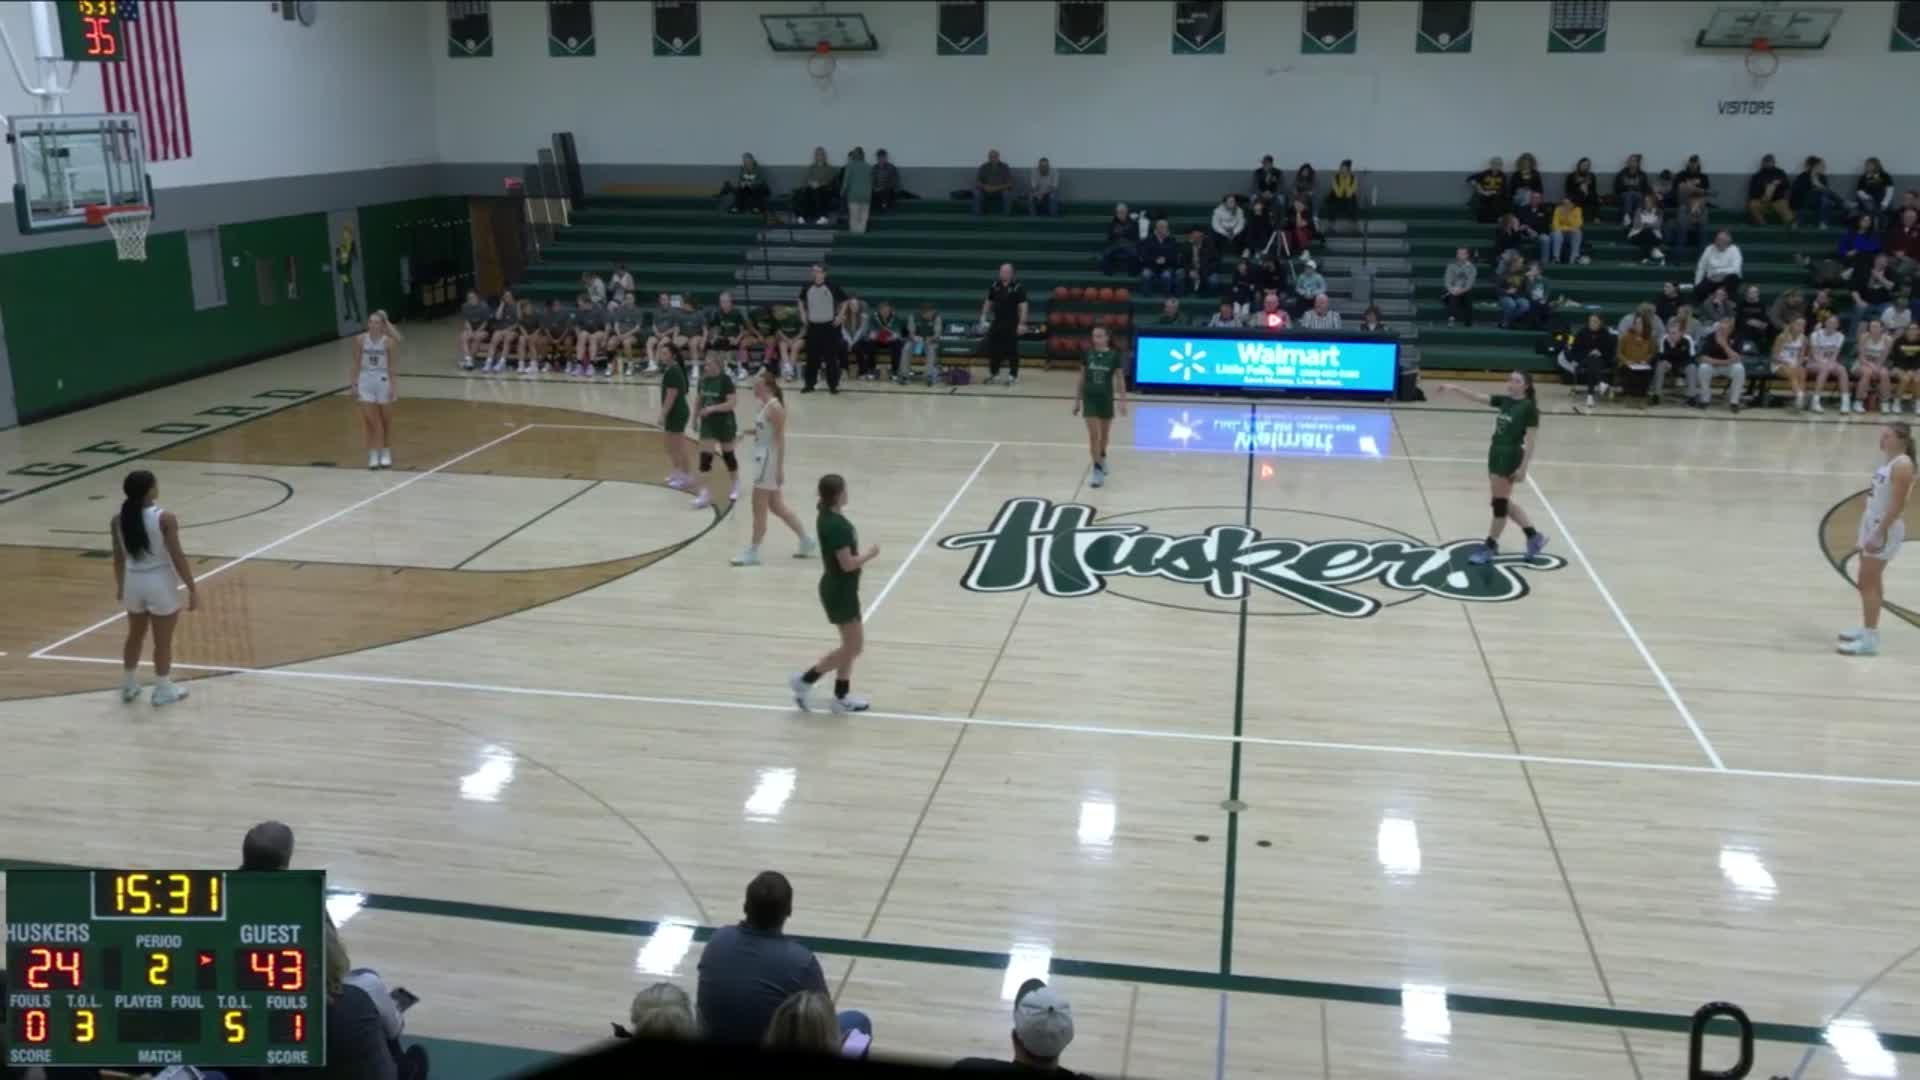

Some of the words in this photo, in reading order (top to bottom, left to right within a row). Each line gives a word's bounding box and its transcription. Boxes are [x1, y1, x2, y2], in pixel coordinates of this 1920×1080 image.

[83, 17, 116, 54] 35
[1717, 100, 1775, 115] VISITORS
[1237, 342, 1340, 366] Walmart
[0, 389, 317, 495] GFORD
[938, 497, 1568, 619] Huskers
